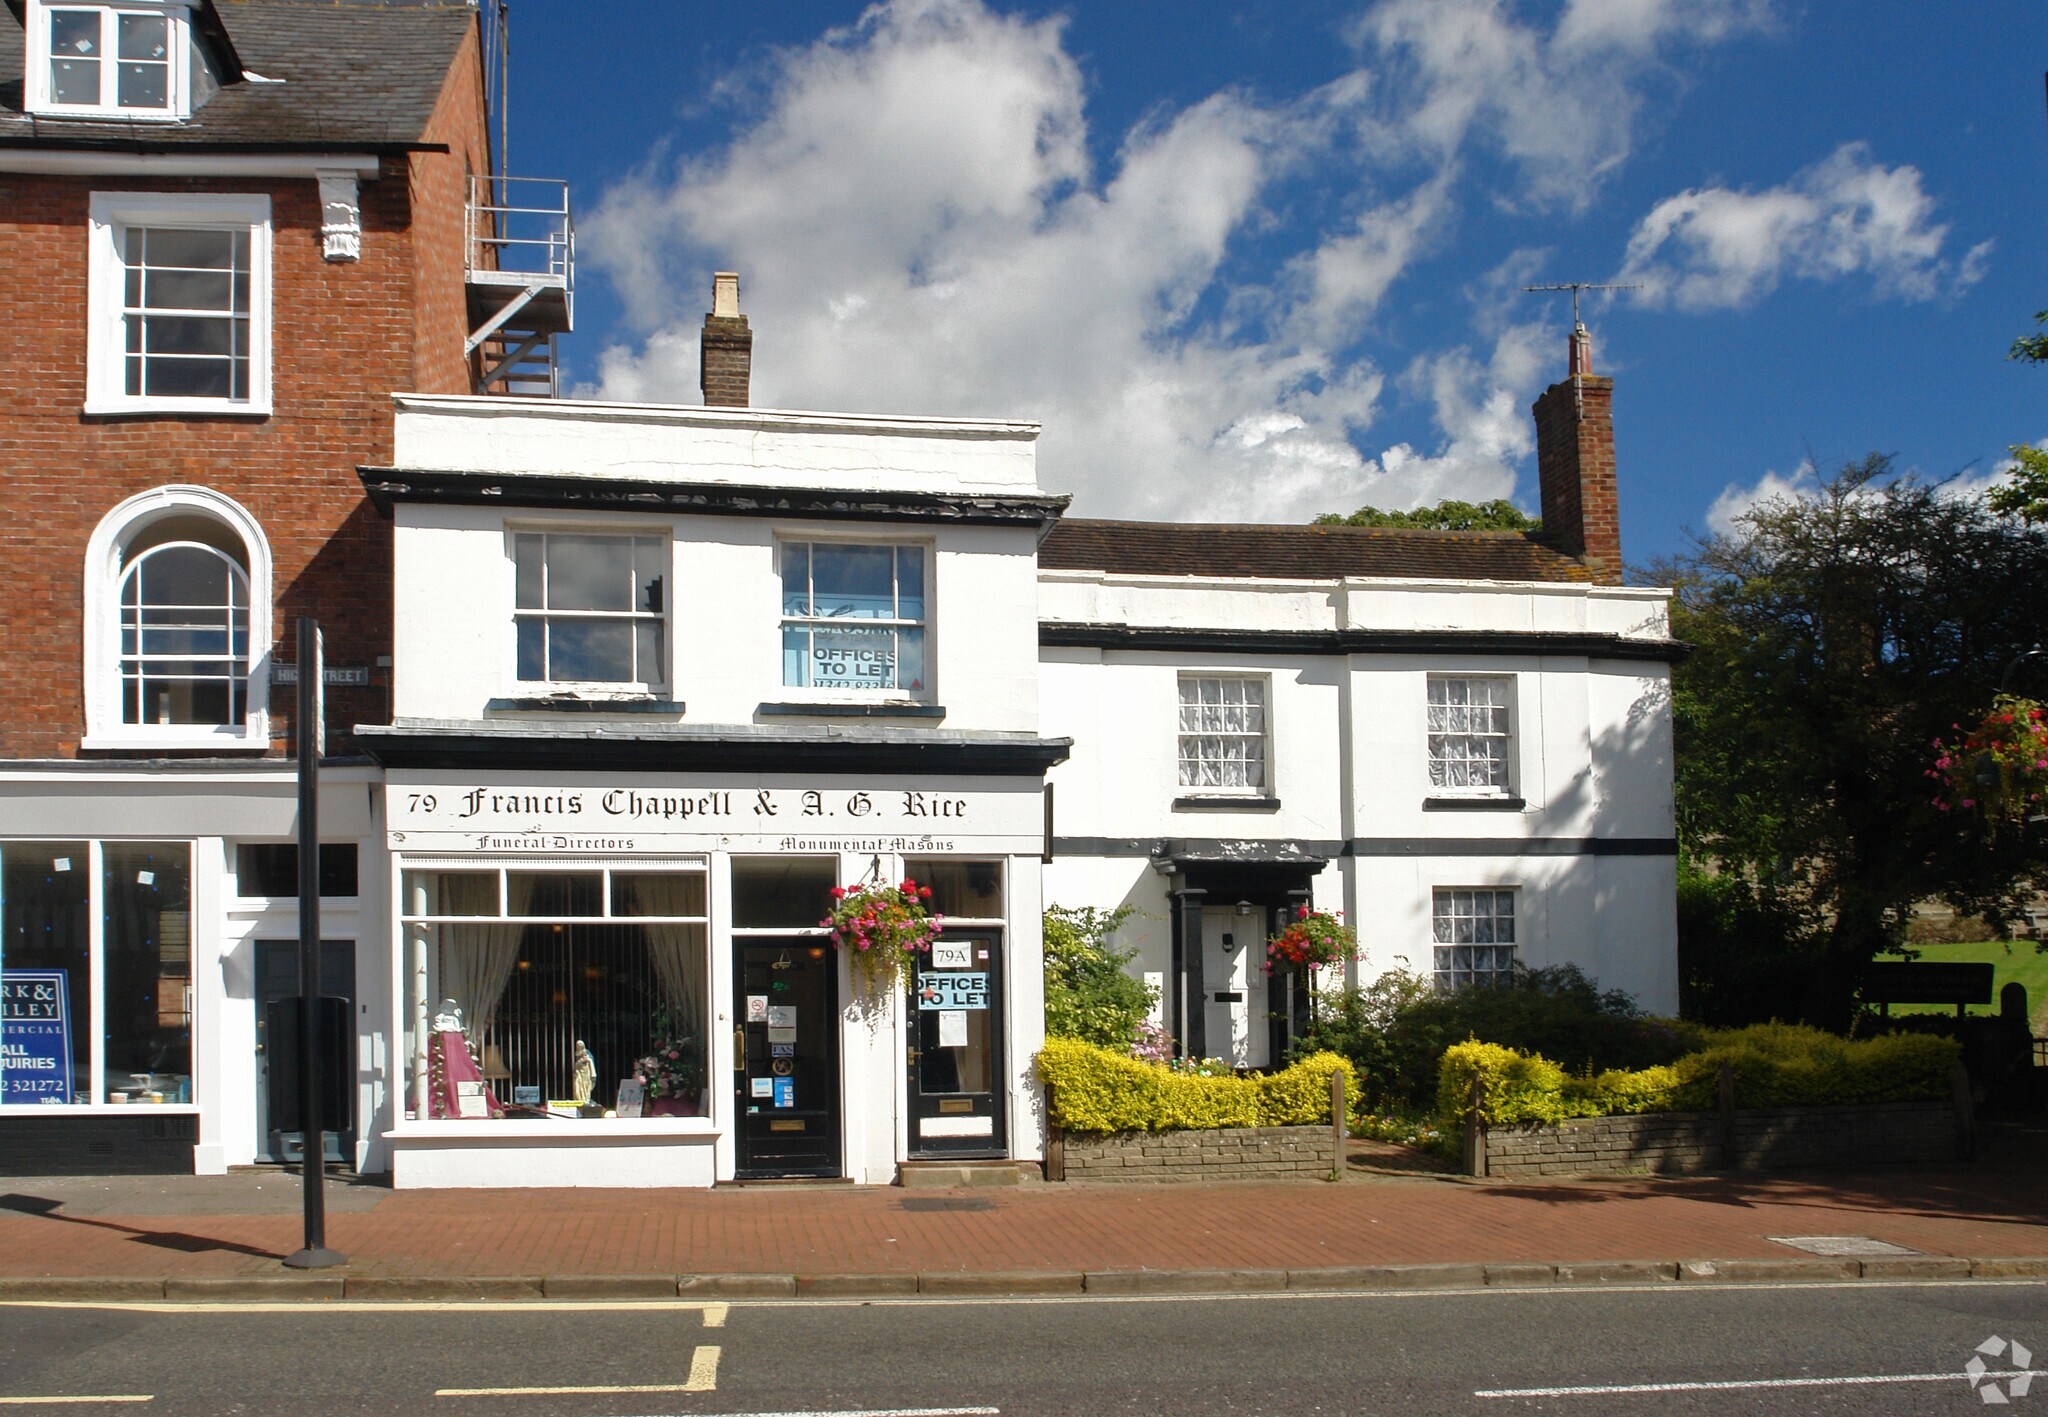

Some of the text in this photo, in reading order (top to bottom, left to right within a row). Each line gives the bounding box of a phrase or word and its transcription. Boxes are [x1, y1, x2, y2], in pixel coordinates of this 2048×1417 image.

[813, 648, 895, 662] OFFICES
[278, 670, 362, 682] HIG TREET
[819, 662, 894, 677] TO LET
[407, 793, 437, 813] 79
[458, 787, 583, 818] Francis
[601, 789, 732, 820] Chappell
[752, 790, 779, 816] &
[800, 790, 835, 817] A.
[901, 791, 968, 818] Rice
[475, 835, 547, 850] Funeral
[779, 836, 954, 851] Monumental Masons
[937, 949, 967, 962] 79A
[33, 984, 55, 1001] &
[918, 993, 990, 1005] TO LET
[12, 1080, 64, 1093] 321272
